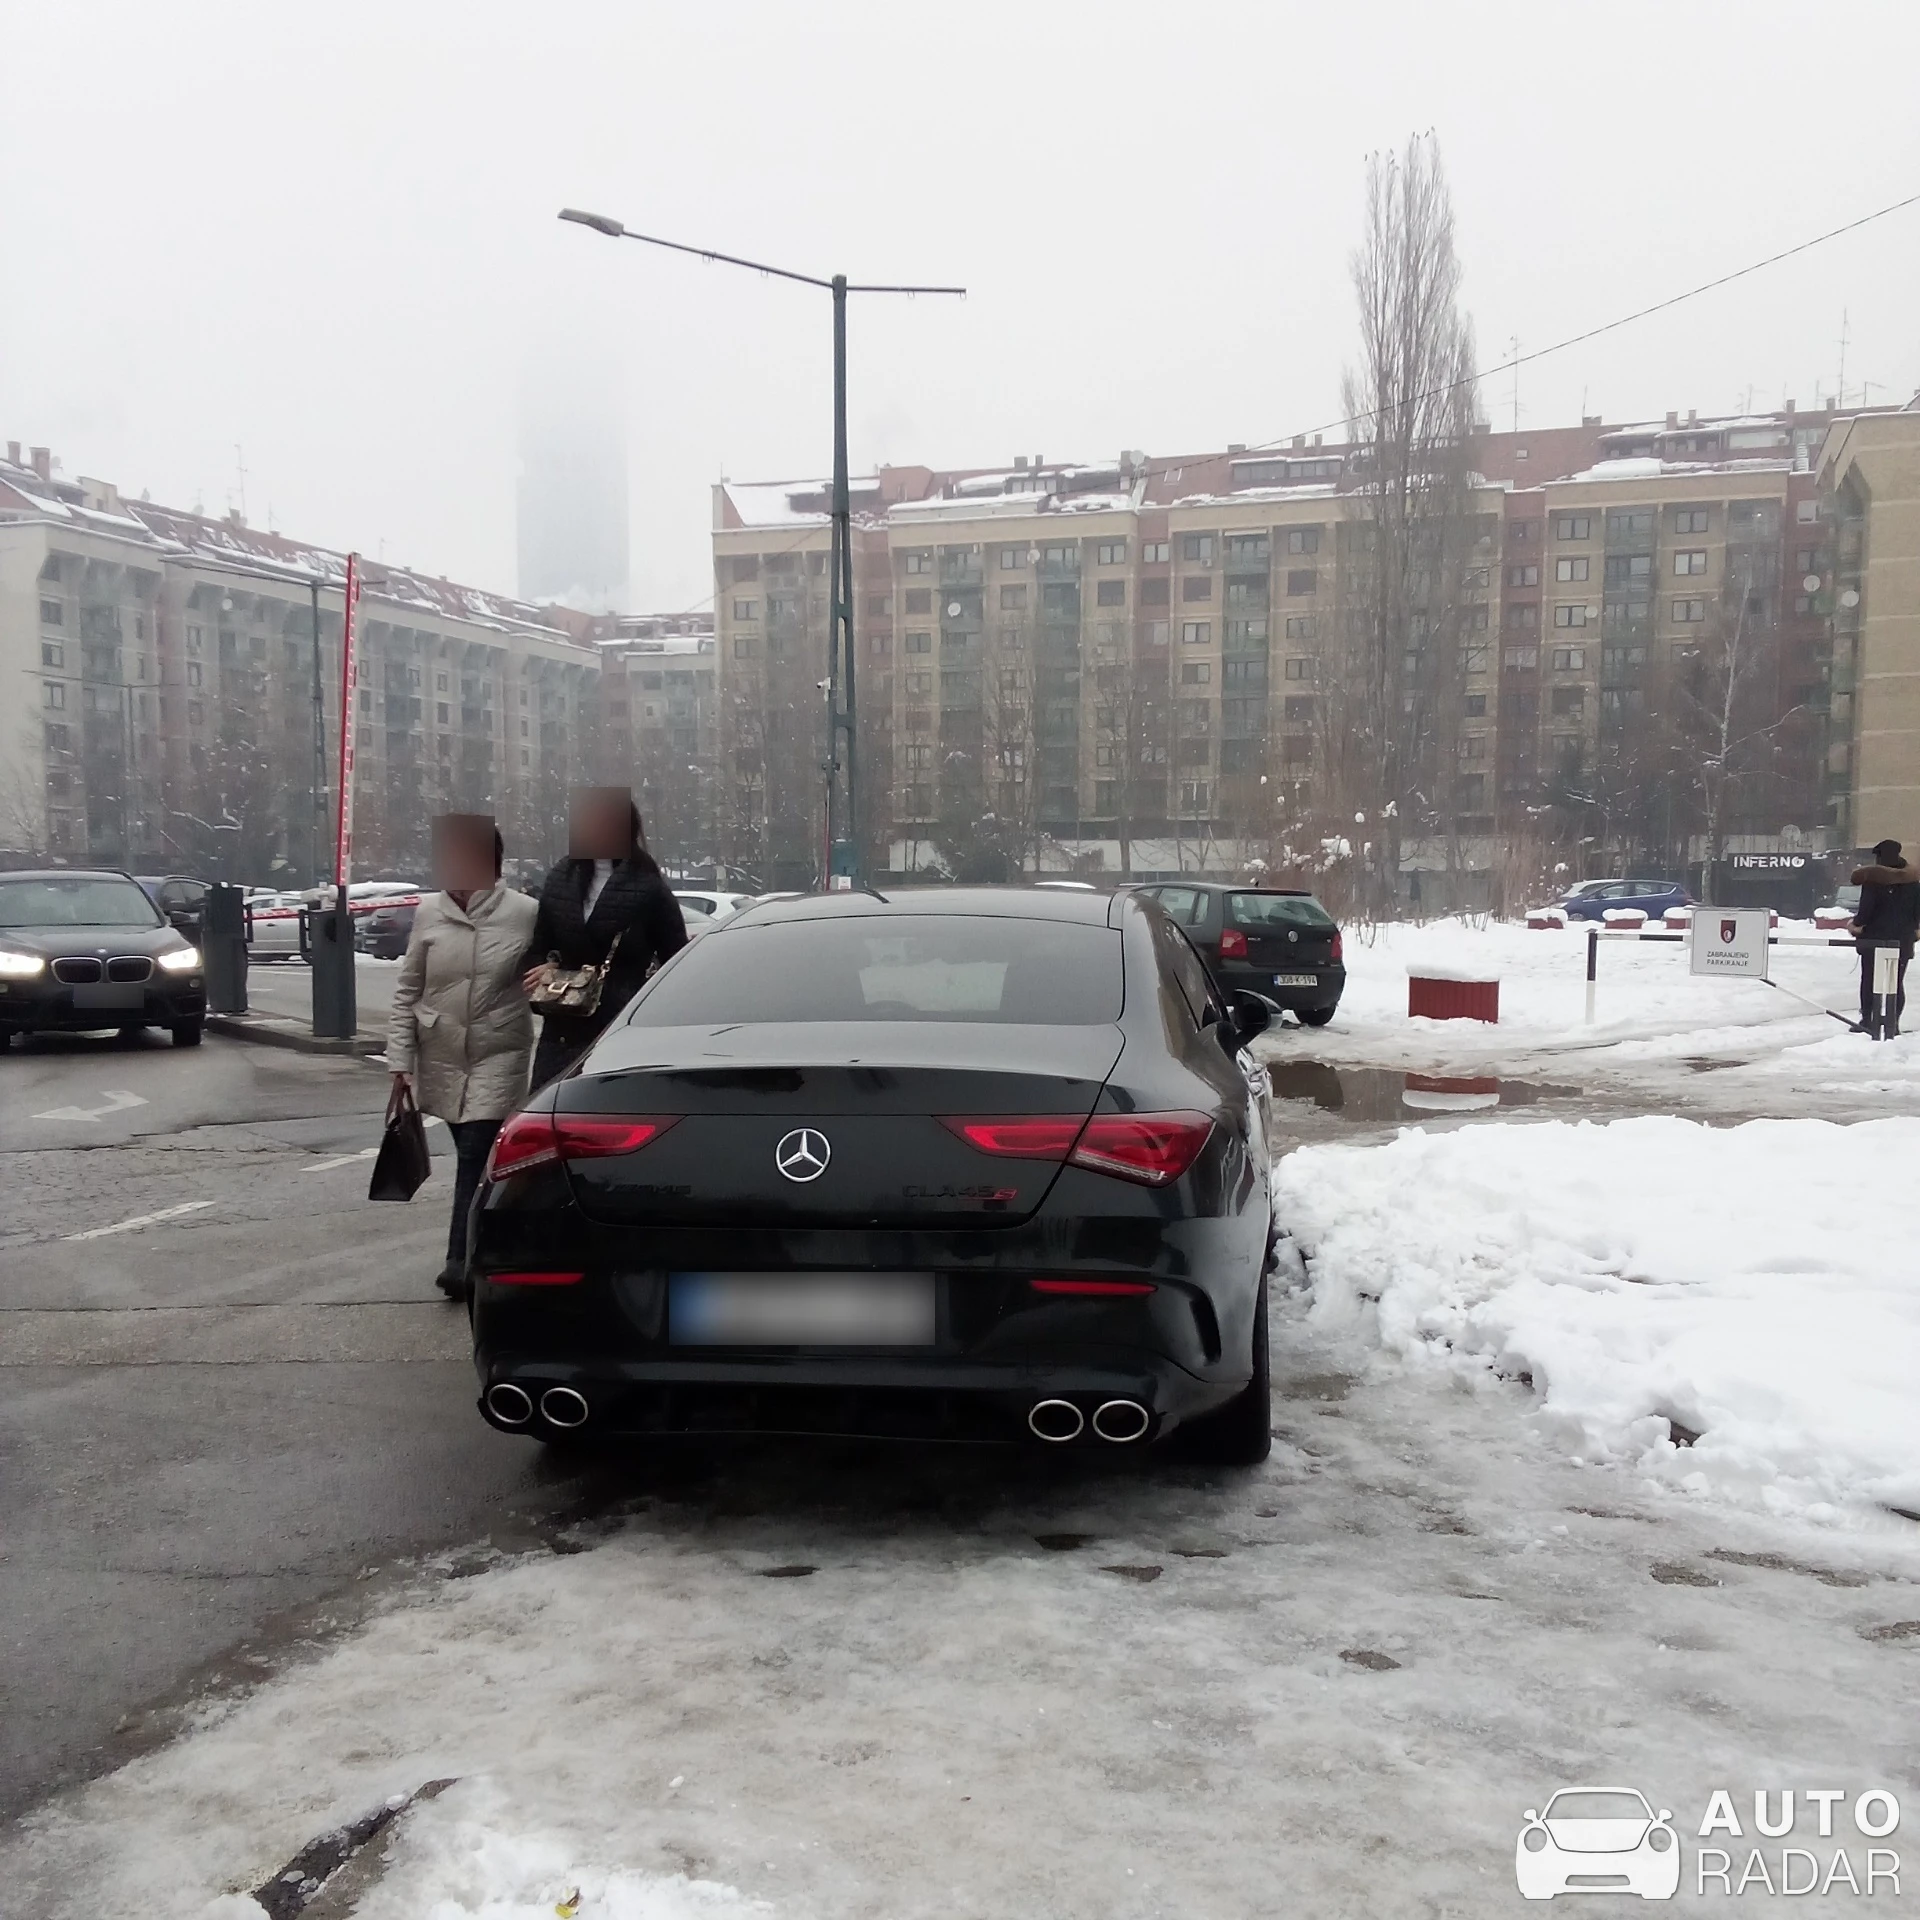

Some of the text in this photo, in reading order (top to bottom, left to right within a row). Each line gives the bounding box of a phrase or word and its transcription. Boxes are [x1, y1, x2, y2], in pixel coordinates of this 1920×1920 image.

[1733, 856, 1805, 868] INFERNO
[1707, 951, 1749, 959] ZABRANJENO
[1707, 959, 1748, 967] PARKIRANJE
